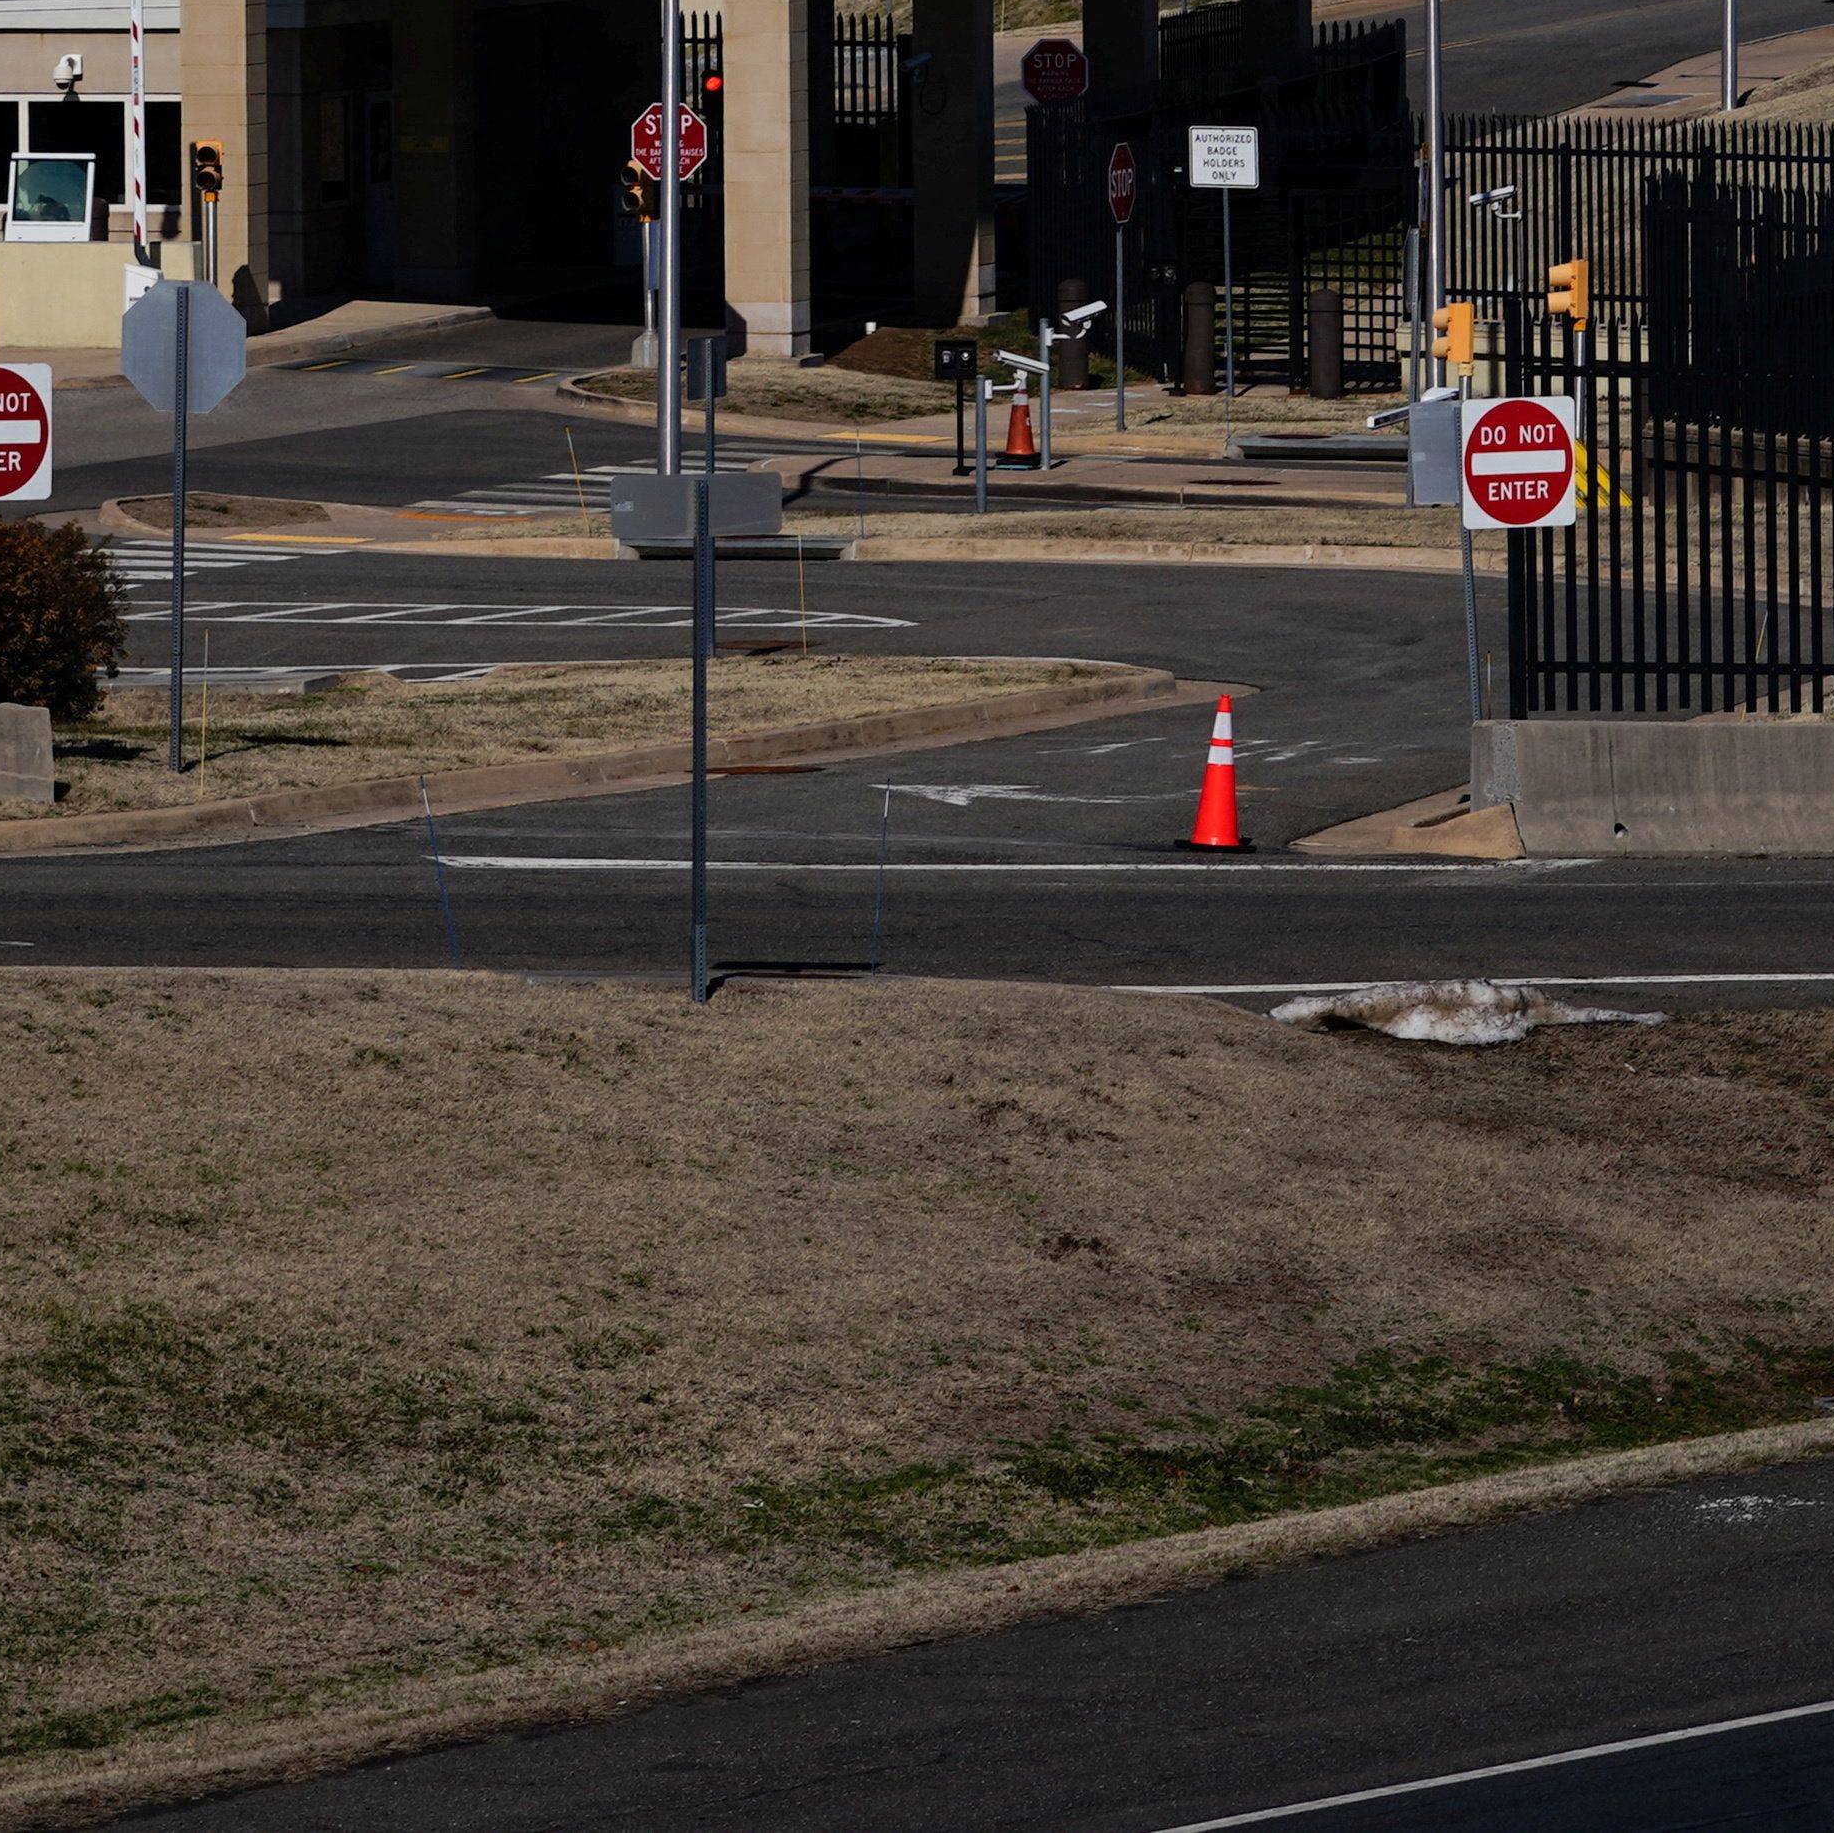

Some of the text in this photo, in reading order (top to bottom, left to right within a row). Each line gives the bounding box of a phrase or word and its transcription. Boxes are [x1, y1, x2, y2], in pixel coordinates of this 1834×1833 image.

[1033, 53, 1077, 69] STOP
[645, 114, 693, 135] STP
[1195, 134, 1252, 143] AUTHORIZED
[1207, 146, 1238, 155] BADGE
[1203, 158, 1246, 167] HOLDERS
[1111, 168, 1133, 198] STOP
[1212, 171, 1237, 180] ONLY
[1481, 424, 1556, 445] DO NOT
[1488, 480, 1548, 501] ENTER
